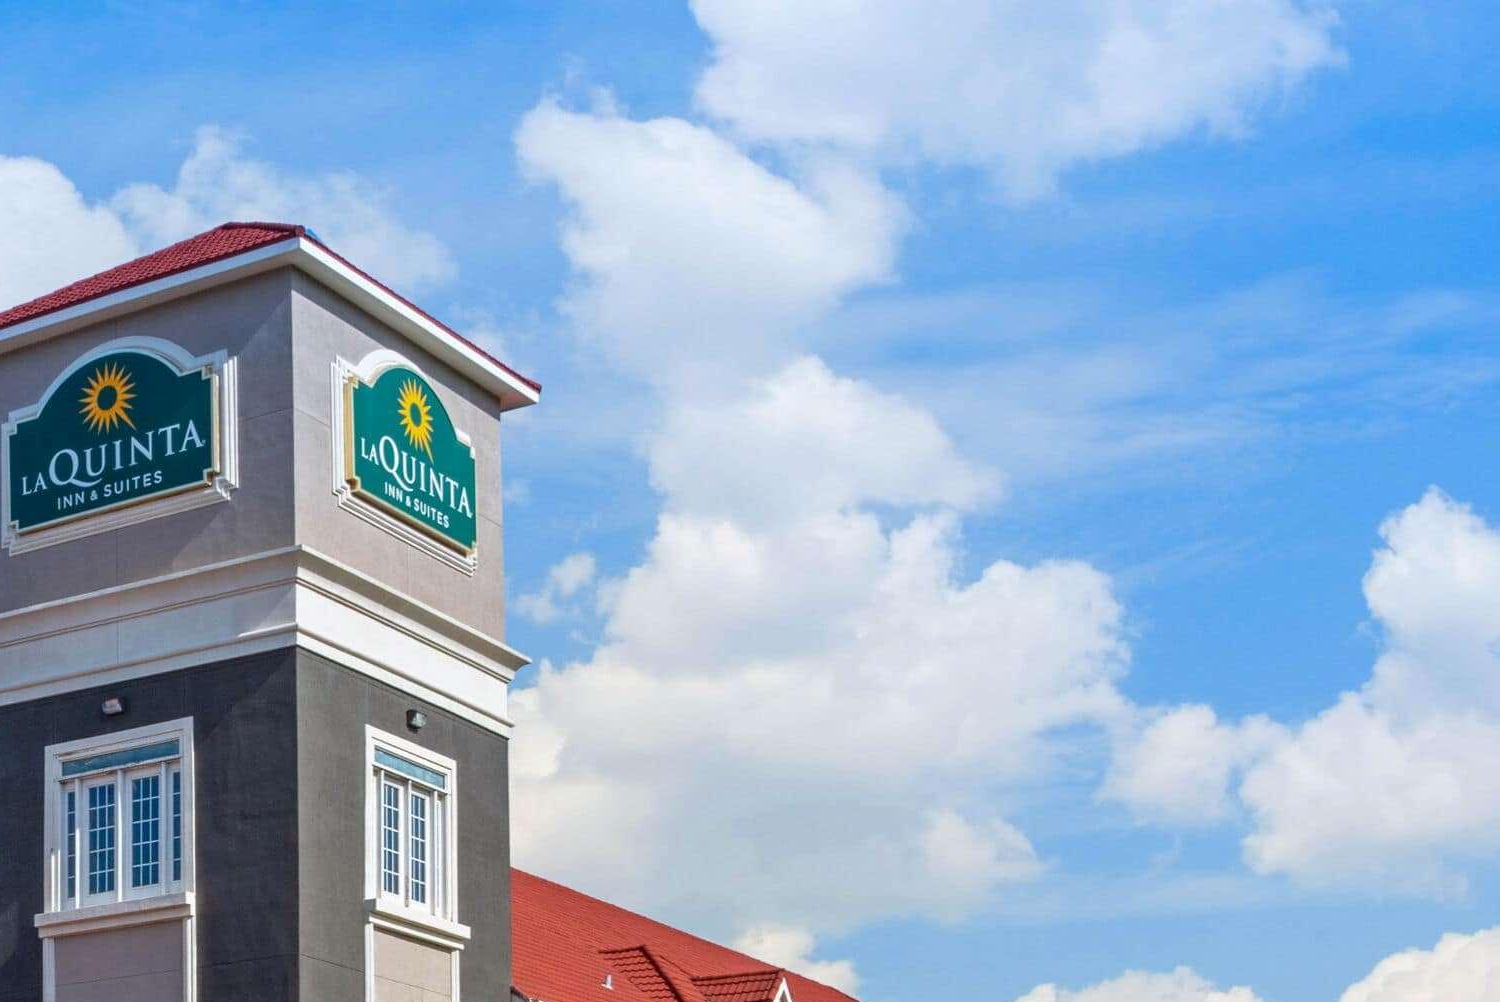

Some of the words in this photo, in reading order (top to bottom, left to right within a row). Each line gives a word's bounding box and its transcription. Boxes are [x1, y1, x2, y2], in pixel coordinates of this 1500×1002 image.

[22, 471, 48, 495] LA
[49, 419, 204, 488] QUINTA
[361, 437, 379, 465] LA
[379, 435, 473, 519] QUINTA
[57, 491, 85, 510] INN
[90, 490, 98, 501] &
[103, 470, 163, 497] SUITES
[384, 481, 403, 503] INN
[405, 495, 411, 507] &
[413, 498, 450, 528] SUITES
